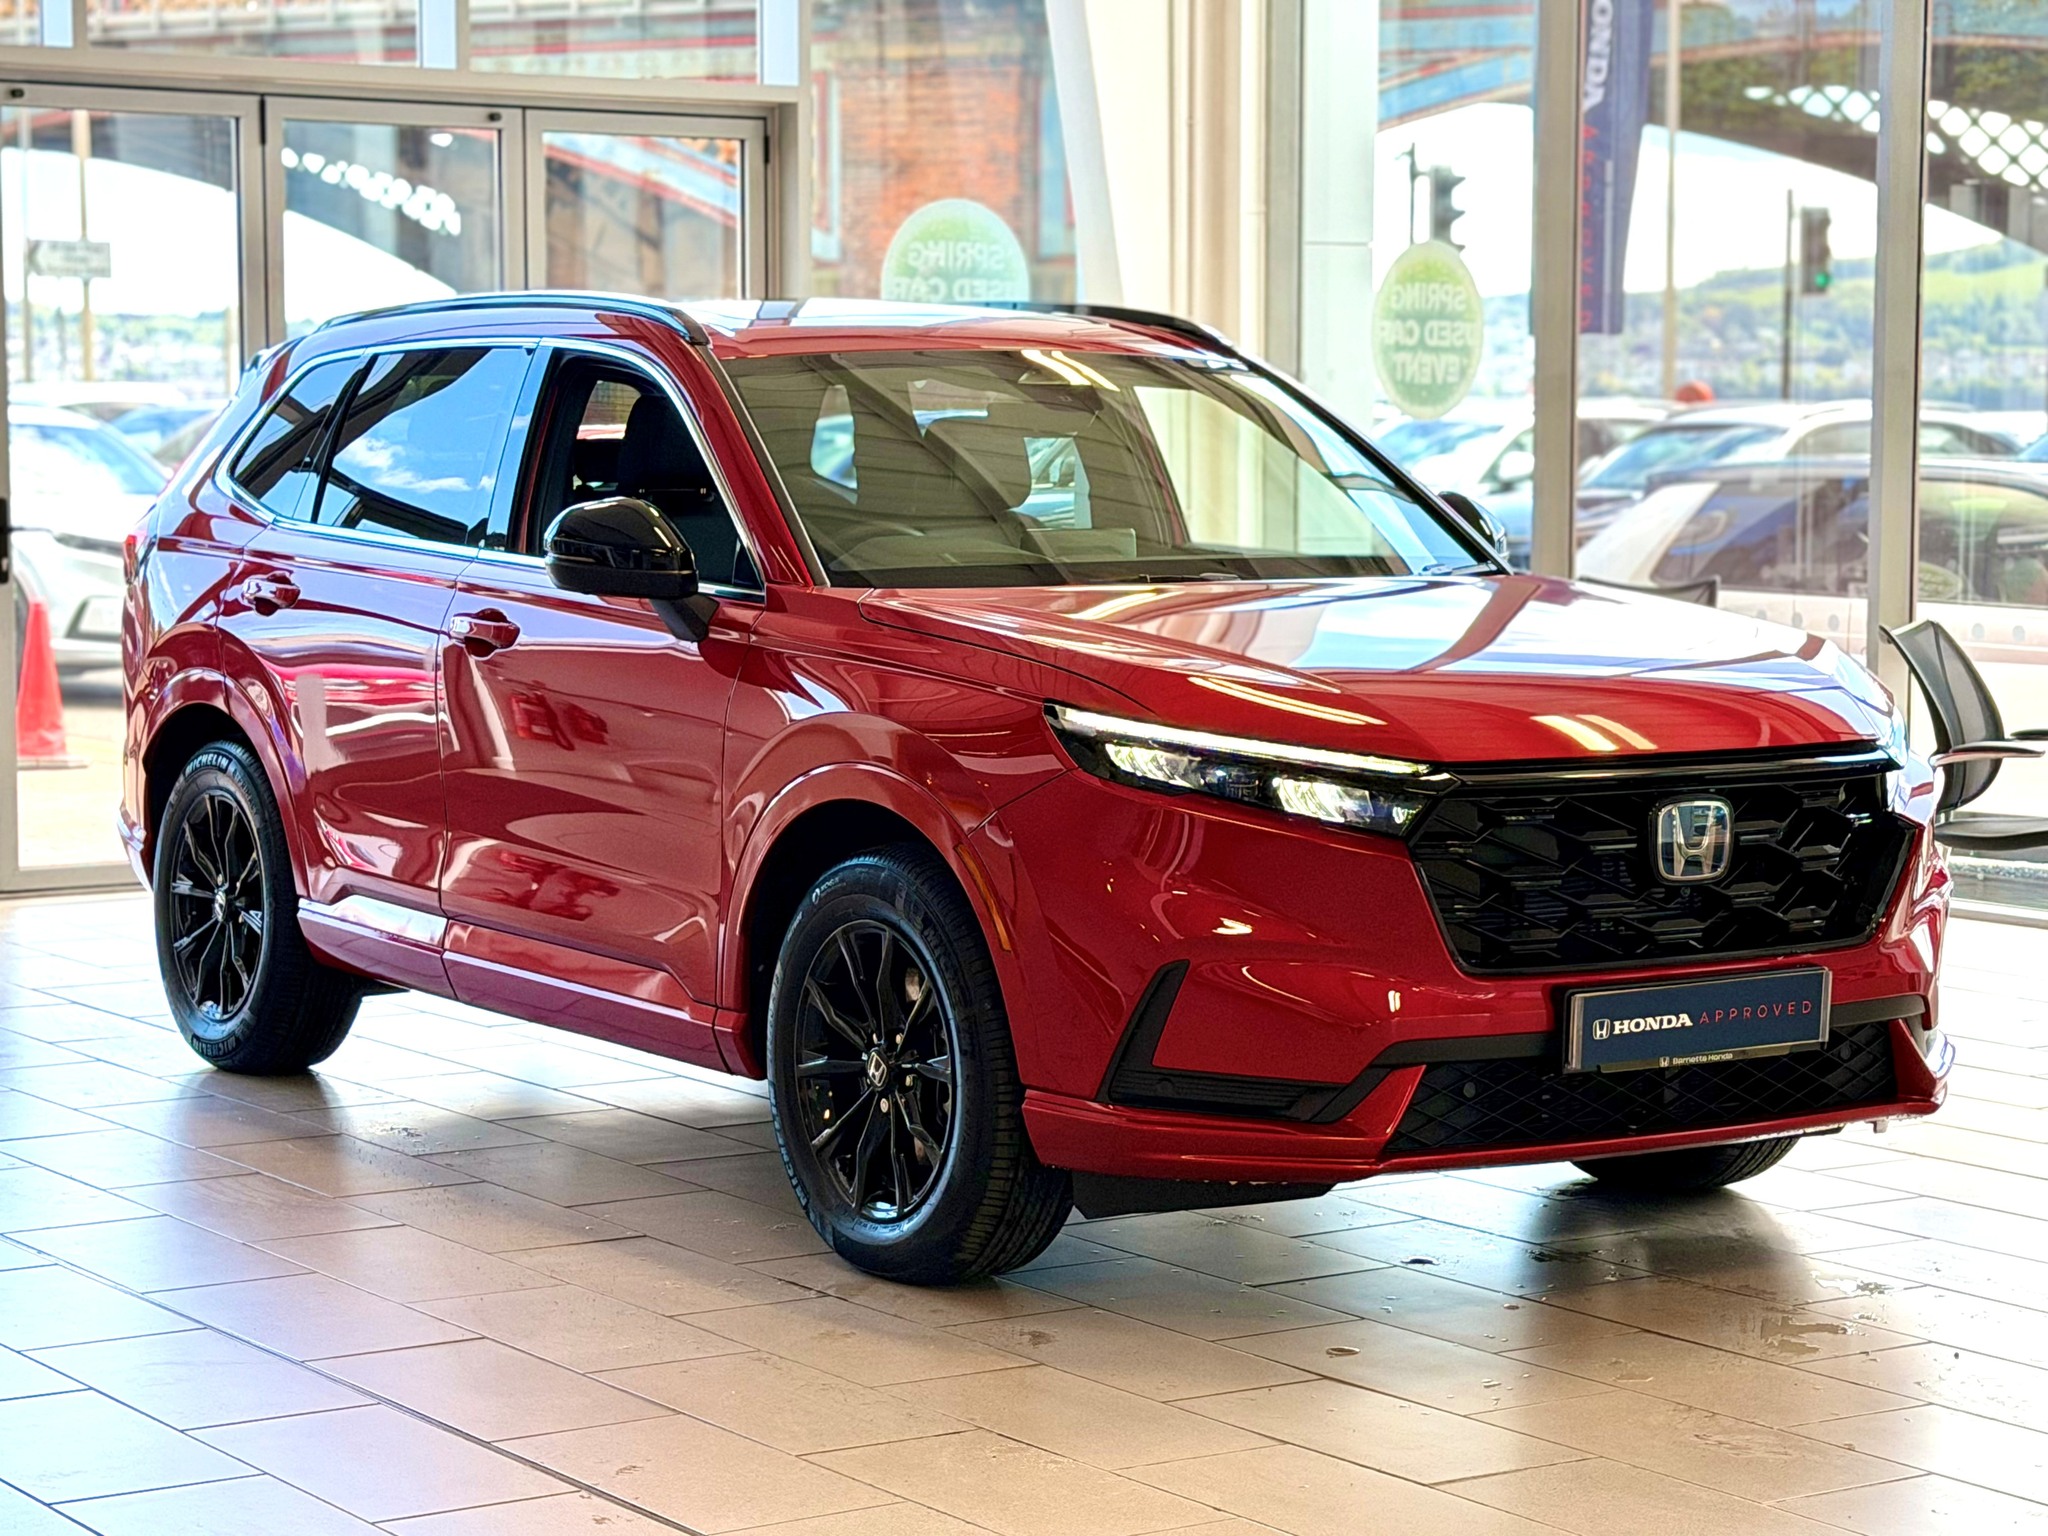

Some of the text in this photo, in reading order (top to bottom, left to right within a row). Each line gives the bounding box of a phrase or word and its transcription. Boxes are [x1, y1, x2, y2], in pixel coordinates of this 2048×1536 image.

[1583, 0, 1613, 112] ONDA
[184, 753, 230, 778] MICHELIN
[1612, 1012, 1693, 1035] HONDA
[1699, 1000, 1812, 1025] APPROVED
[192, 1034, 237, 1057] MICHELIN
[1708, 1052, 1733, 1061] Honda
